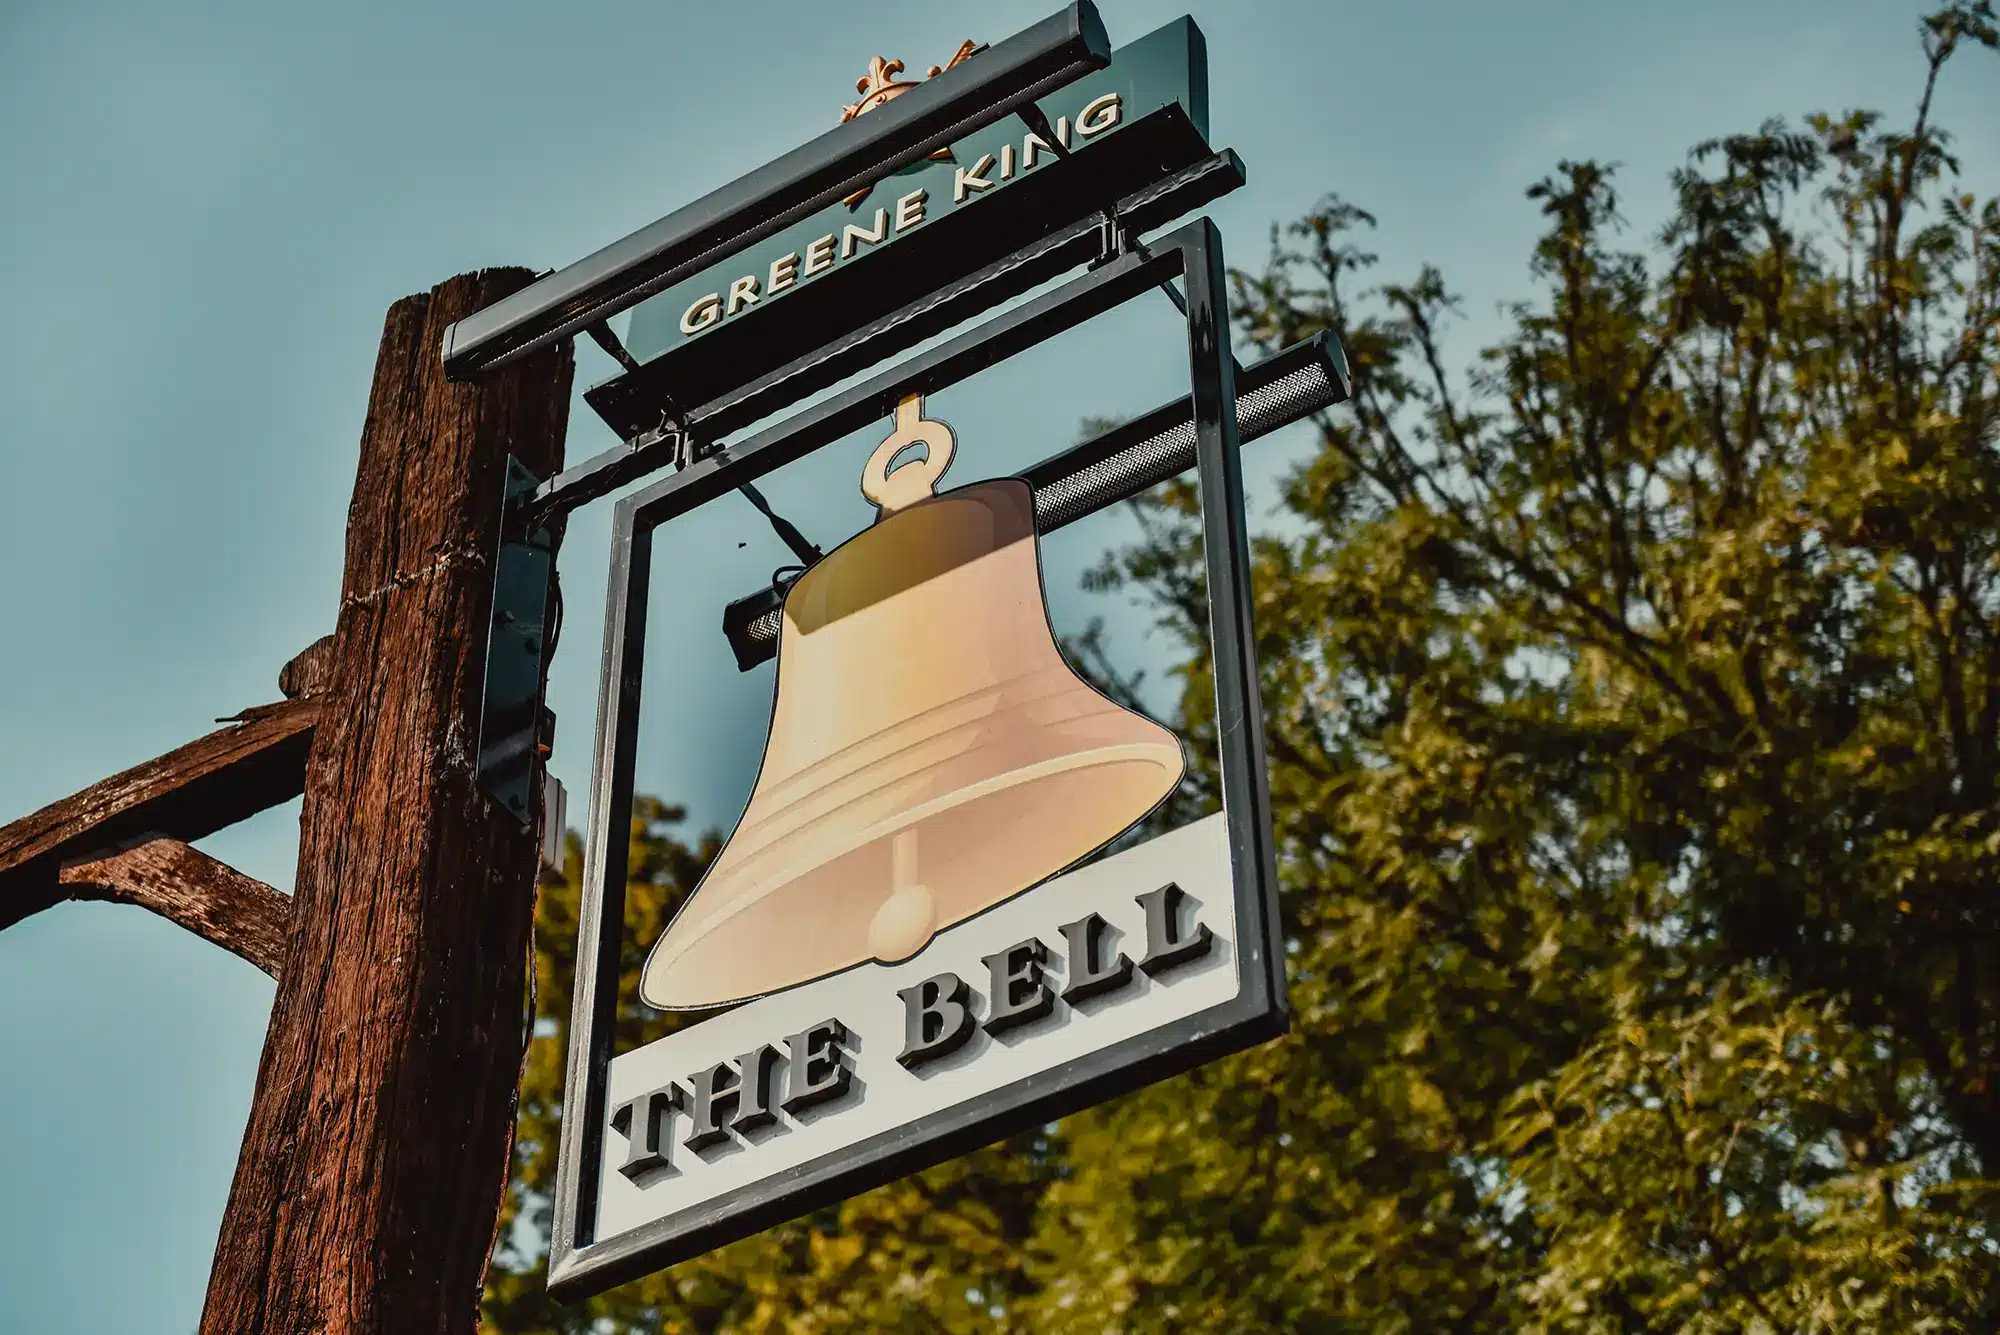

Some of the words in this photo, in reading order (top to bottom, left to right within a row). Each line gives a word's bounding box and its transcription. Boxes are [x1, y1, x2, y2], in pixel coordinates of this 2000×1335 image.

[679, 187, 930, 336] GREENE
[953, 92, 1123, 203] KING
[609, 1017, 853, 1184] THE
[896, 881, 1213, 1070] BELL
